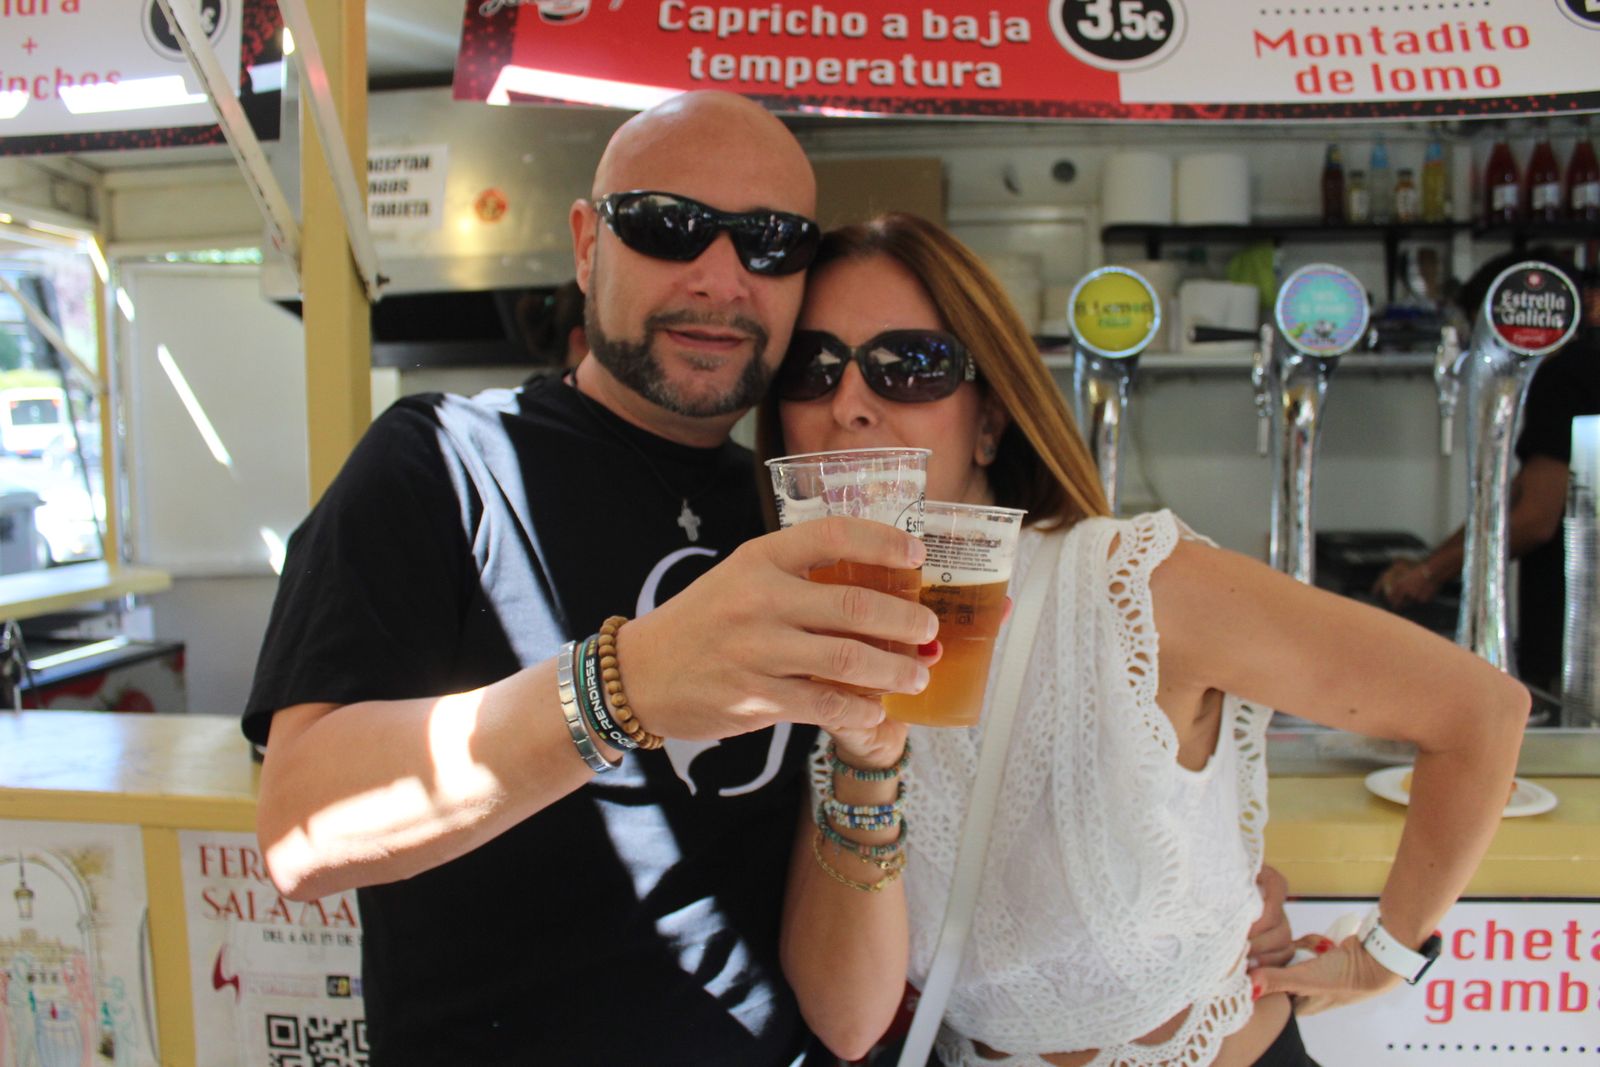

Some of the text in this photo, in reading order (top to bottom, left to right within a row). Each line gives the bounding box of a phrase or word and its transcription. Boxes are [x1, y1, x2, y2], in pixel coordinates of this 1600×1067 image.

[658, 0, 868, 39] Capricho
[882, 13, 909, 40] a
[922, 9, 1031, 47] baja
[1253, 20, 1531, 59] Montadito
[688, 46, 1002, 89] temperatura
[1295, 62, 1502, 94] de lomo
[1501, 306, 1564, 329] Galicia
[1502, 289, 1566, 311] Estrella
[586, 657, 613, 731] RENDIRSE
[1434, 920, 1600, 961] chet
[1425, 972, 1600, 1024] gamb
